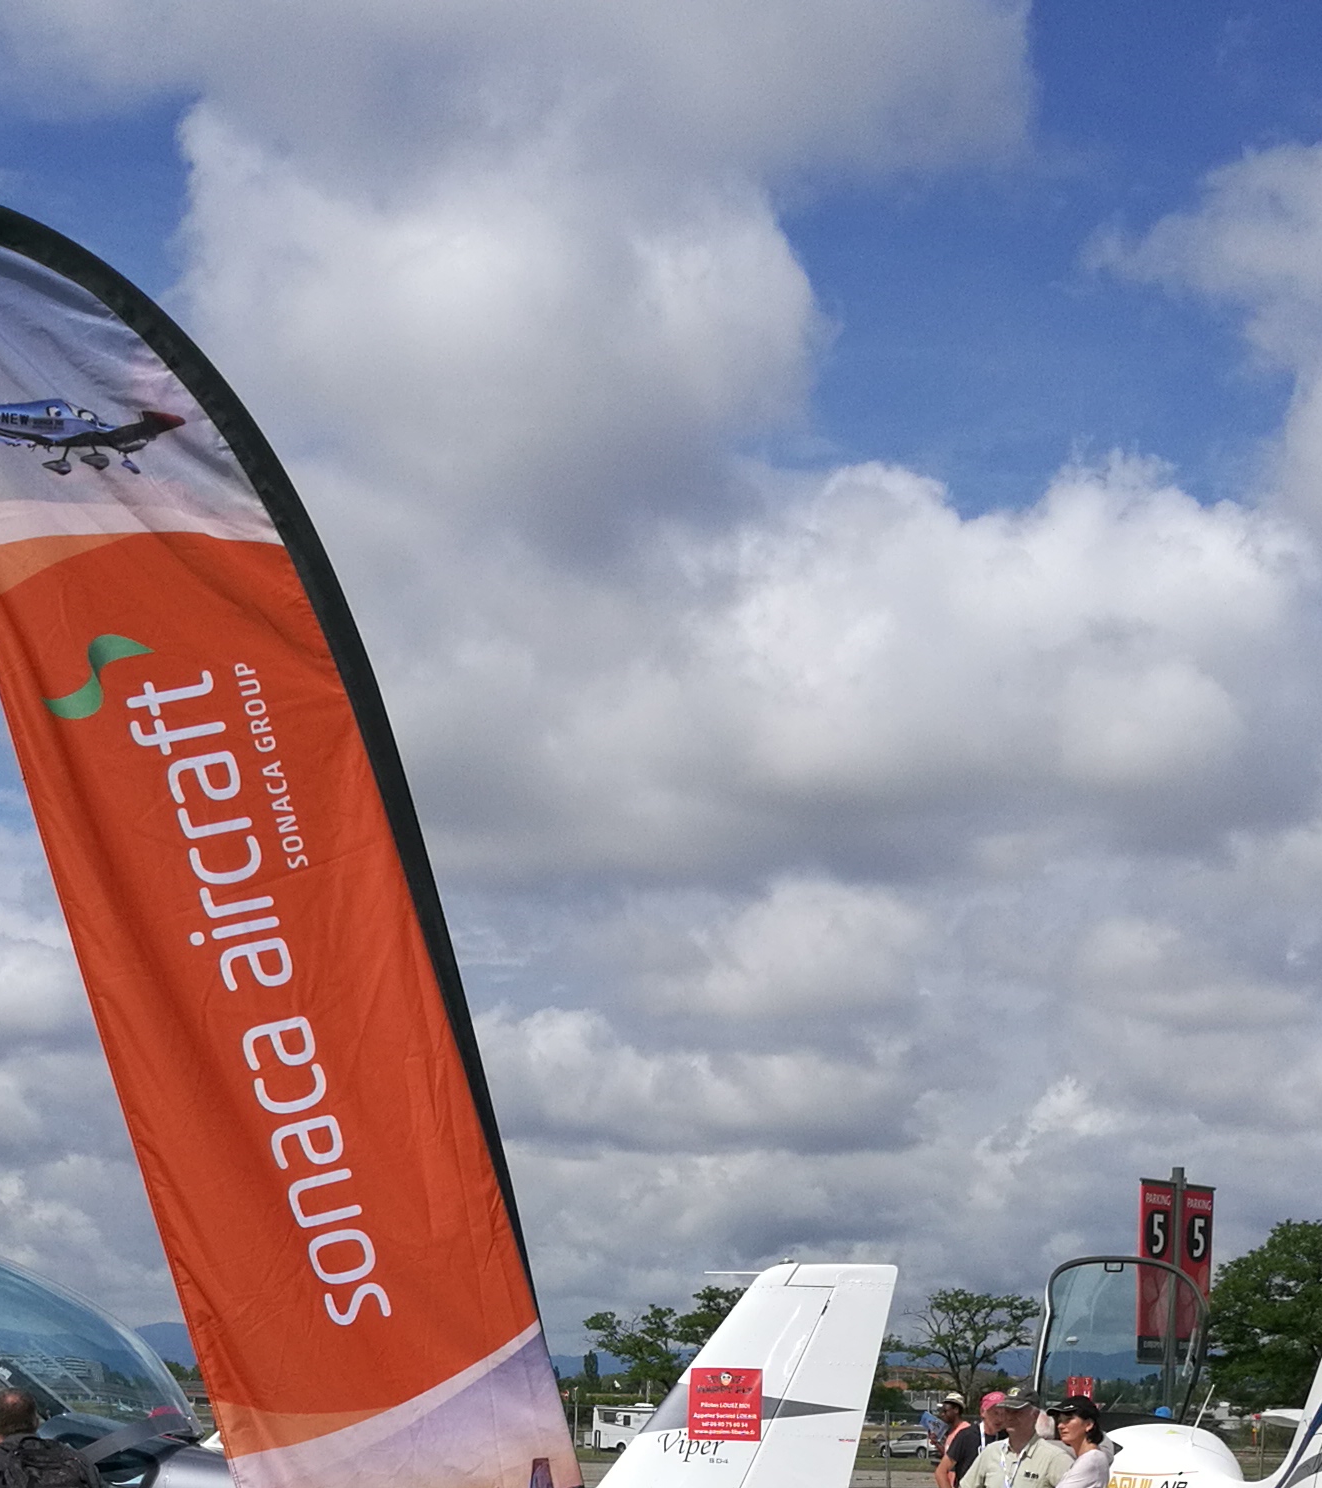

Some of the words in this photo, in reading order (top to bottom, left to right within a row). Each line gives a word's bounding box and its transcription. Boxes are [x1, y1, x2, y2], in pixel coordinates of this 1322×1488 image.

[234, 662, 277, 753] GROUP
[126, 670, 293, 991] aircraft
[262, 760, 309, 869] SONACA
[242, 1015, 392, 1326] sonaca
[1145, 1192, 1172, 1206] PARKING
[1186, 1197, 1212, 1211] PARKING
[1152, 1214, 1165, 1254] 5
[1193, 1218, 1206, 1258] 5
[657, 1430, 725, 1463] Viper
